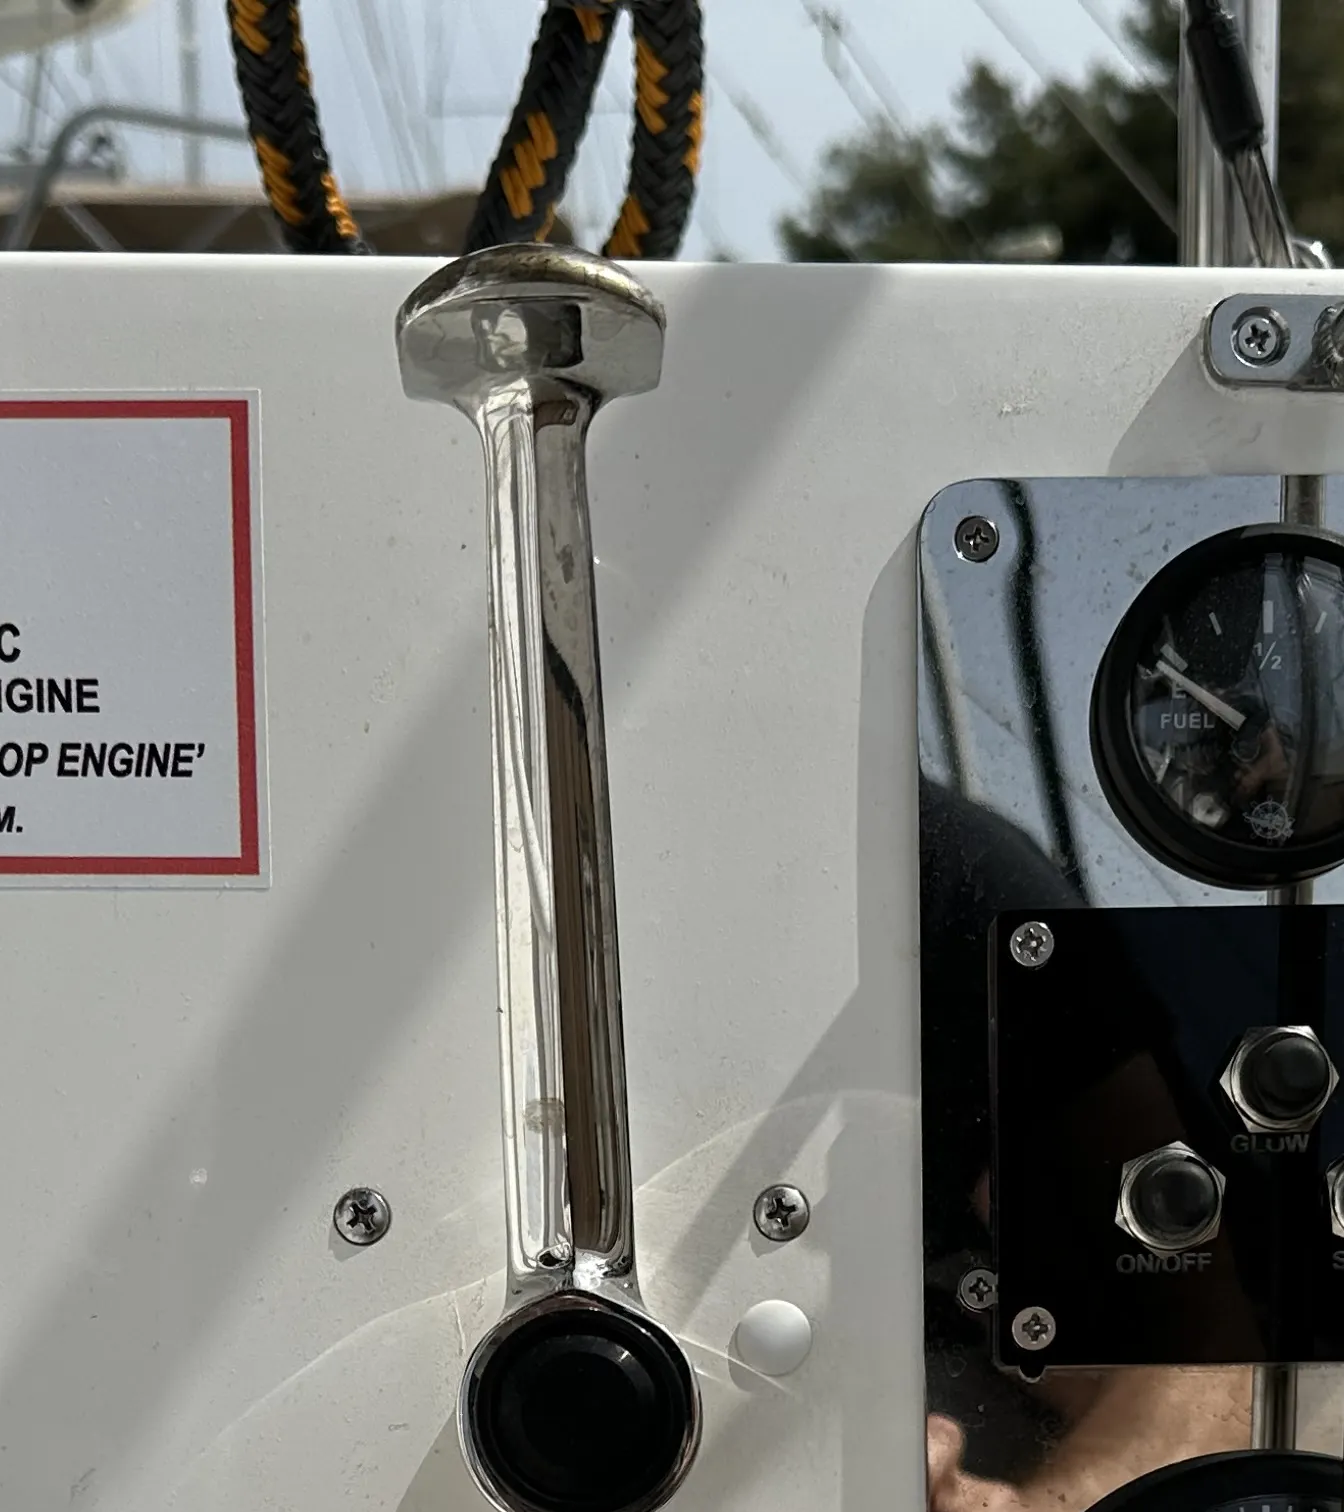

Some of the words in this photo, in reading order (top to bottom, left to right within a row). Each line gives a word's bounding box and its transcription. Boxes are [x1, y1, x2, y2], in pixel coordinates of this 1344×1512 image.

[1160, 712, 1215, 729] FUEL
[1230, 1133, 1311, 1154] GLOW
[1115, 1252, 1213, 1274] ON/OFF
